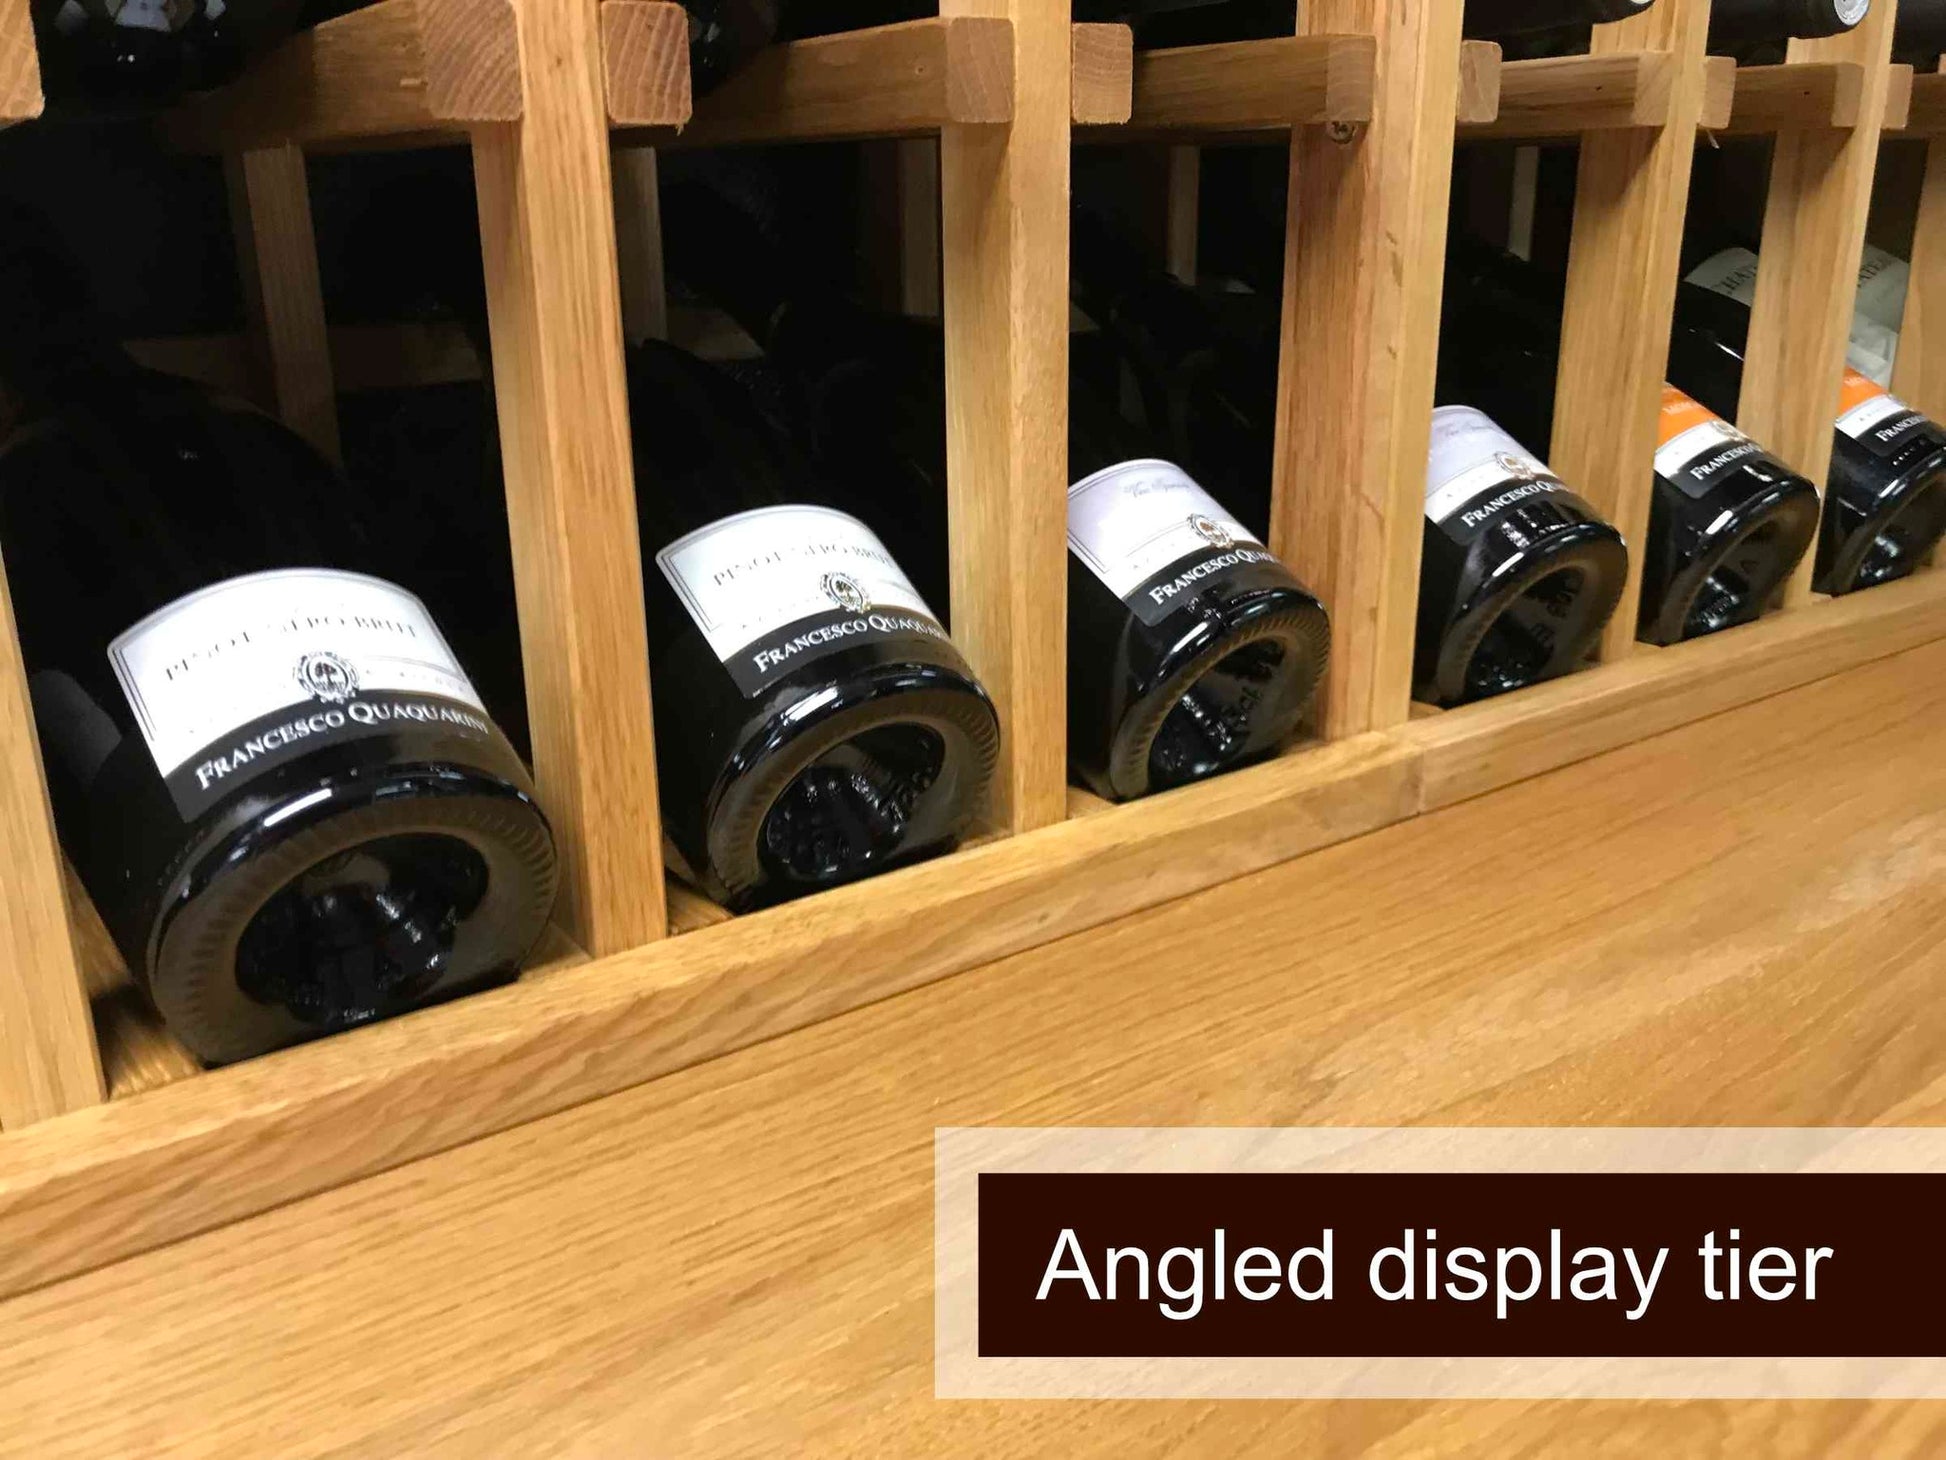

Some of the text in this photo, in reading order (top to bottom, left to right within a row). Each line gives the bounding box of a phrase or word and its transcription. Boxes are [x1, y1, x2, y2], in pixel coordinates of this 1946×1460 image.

[1461, 484, 1540, 527] FRANCESCO
[1149, 554, 1238, 605] FRANCESCO
[753, 618, 868, 674] FRANCESCO
[195, 709, 345, 790] FRANCESCO
